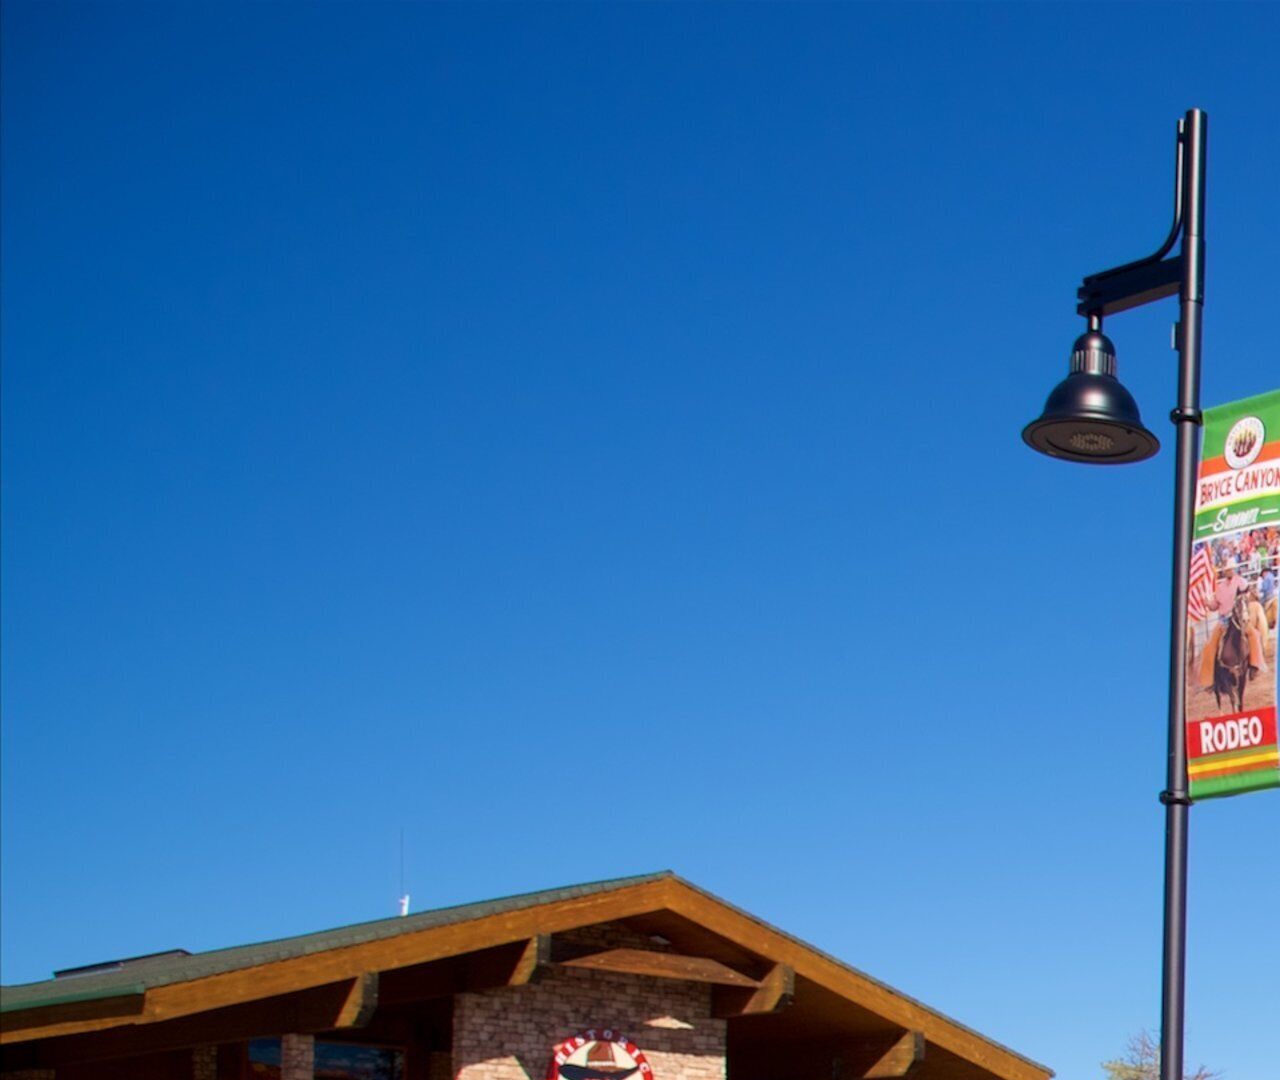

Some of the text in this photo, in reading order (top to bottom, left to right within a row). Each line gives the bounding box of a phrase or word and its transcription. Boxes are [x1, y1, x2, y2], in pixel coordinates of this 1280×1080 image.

[1200, 476, 1233, 506] BRYCE
[1200, 716, 1263, 755] RODEO
[555, 1029, 650, 1073] HISTORIC
